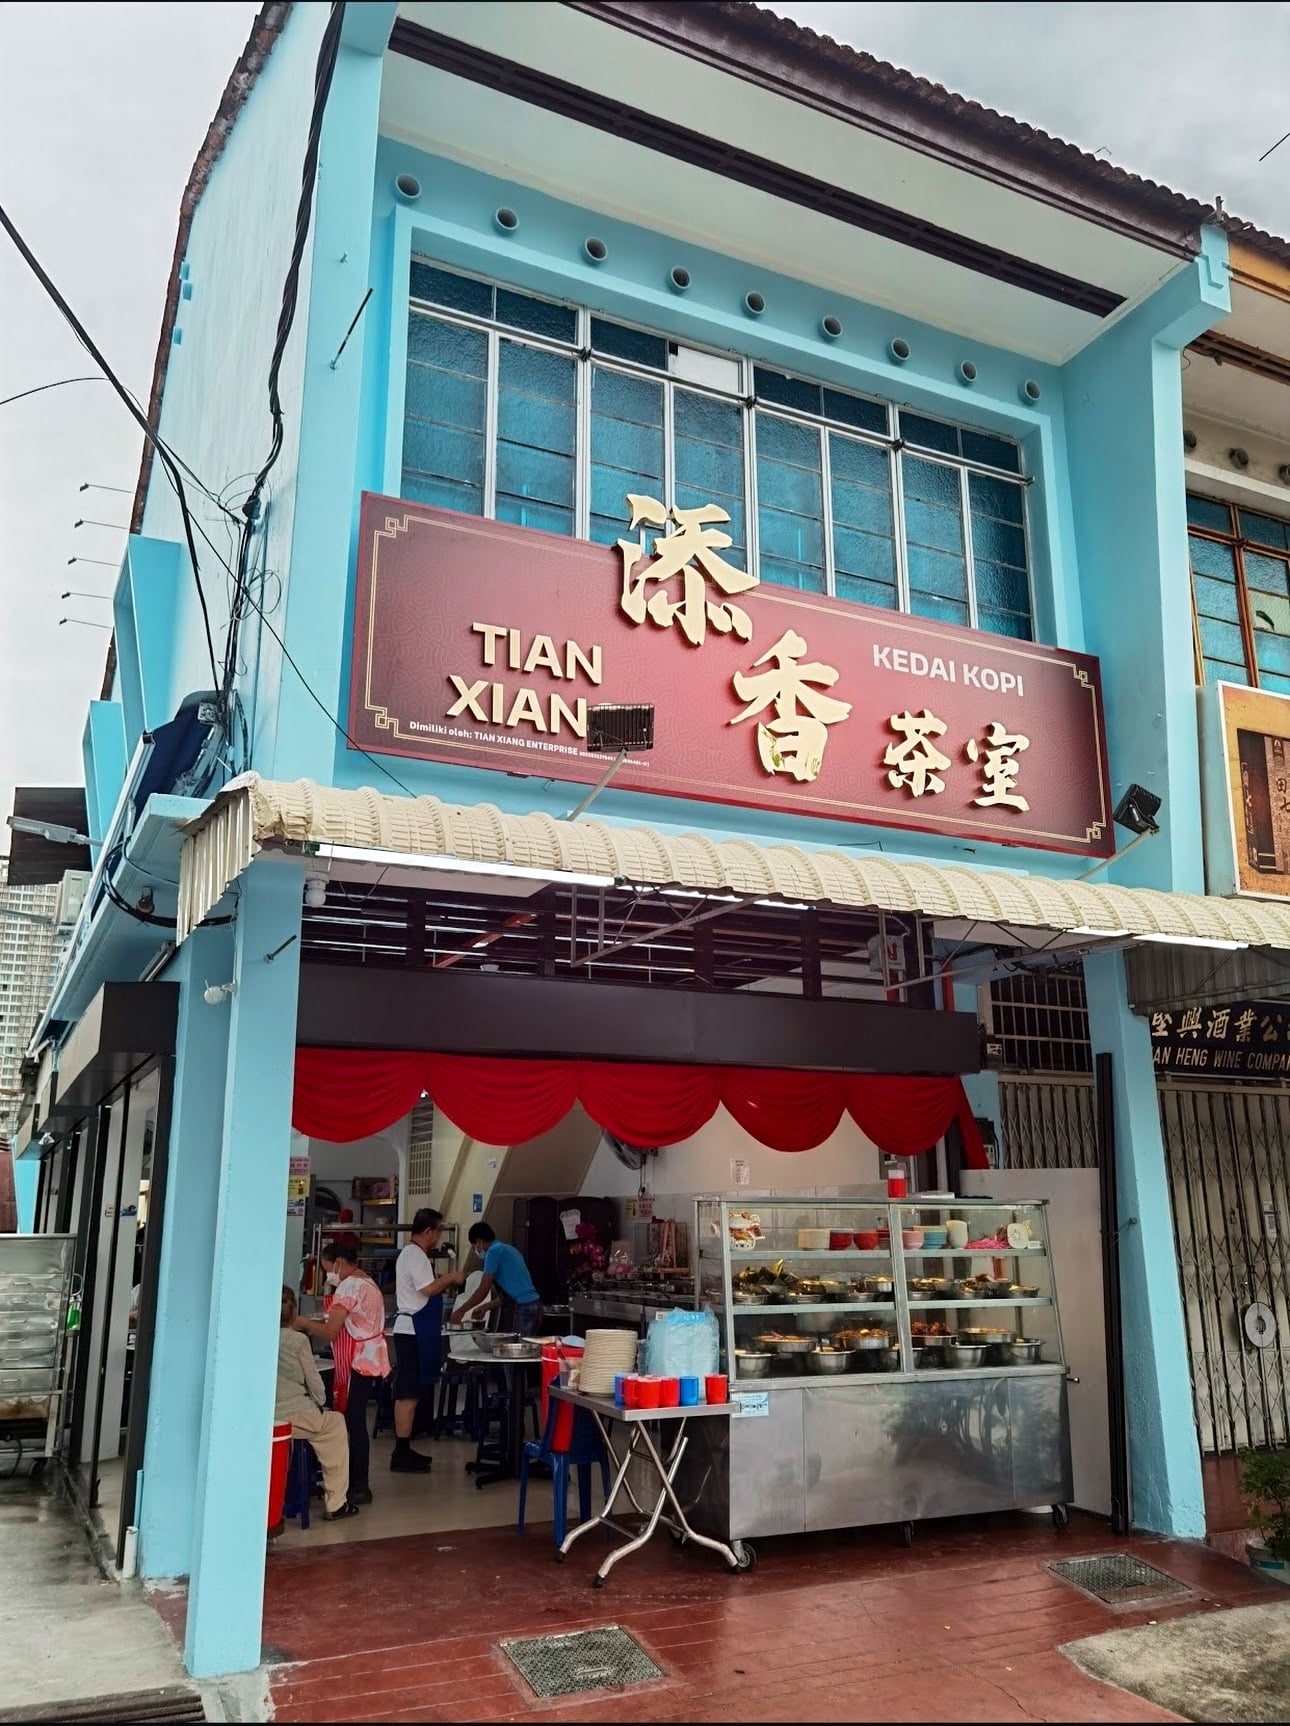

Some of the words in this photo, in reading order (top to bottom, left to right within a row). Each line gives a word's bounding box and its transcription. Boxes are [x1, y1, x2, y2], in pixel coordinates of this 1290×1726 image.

[472, 622, 602, 685] TIAN
[872, 644, 956, 683] KEDAI
[962, 663, 1024, 697] KOPI
[409, 721, 448, 735] Dimiliki
[448, 727, 473, 739] oleh:
[474, 731, 496, 743] TIAN
[496, 735, 525, 748] XIANG
[526, 740, 579, 756] ENTERPRISE
[883, 708, 1031, 814] 茶室
[1175, 1047, 1209, 1067] HENG
[1213, 1050, 1243, 1069] WINE
